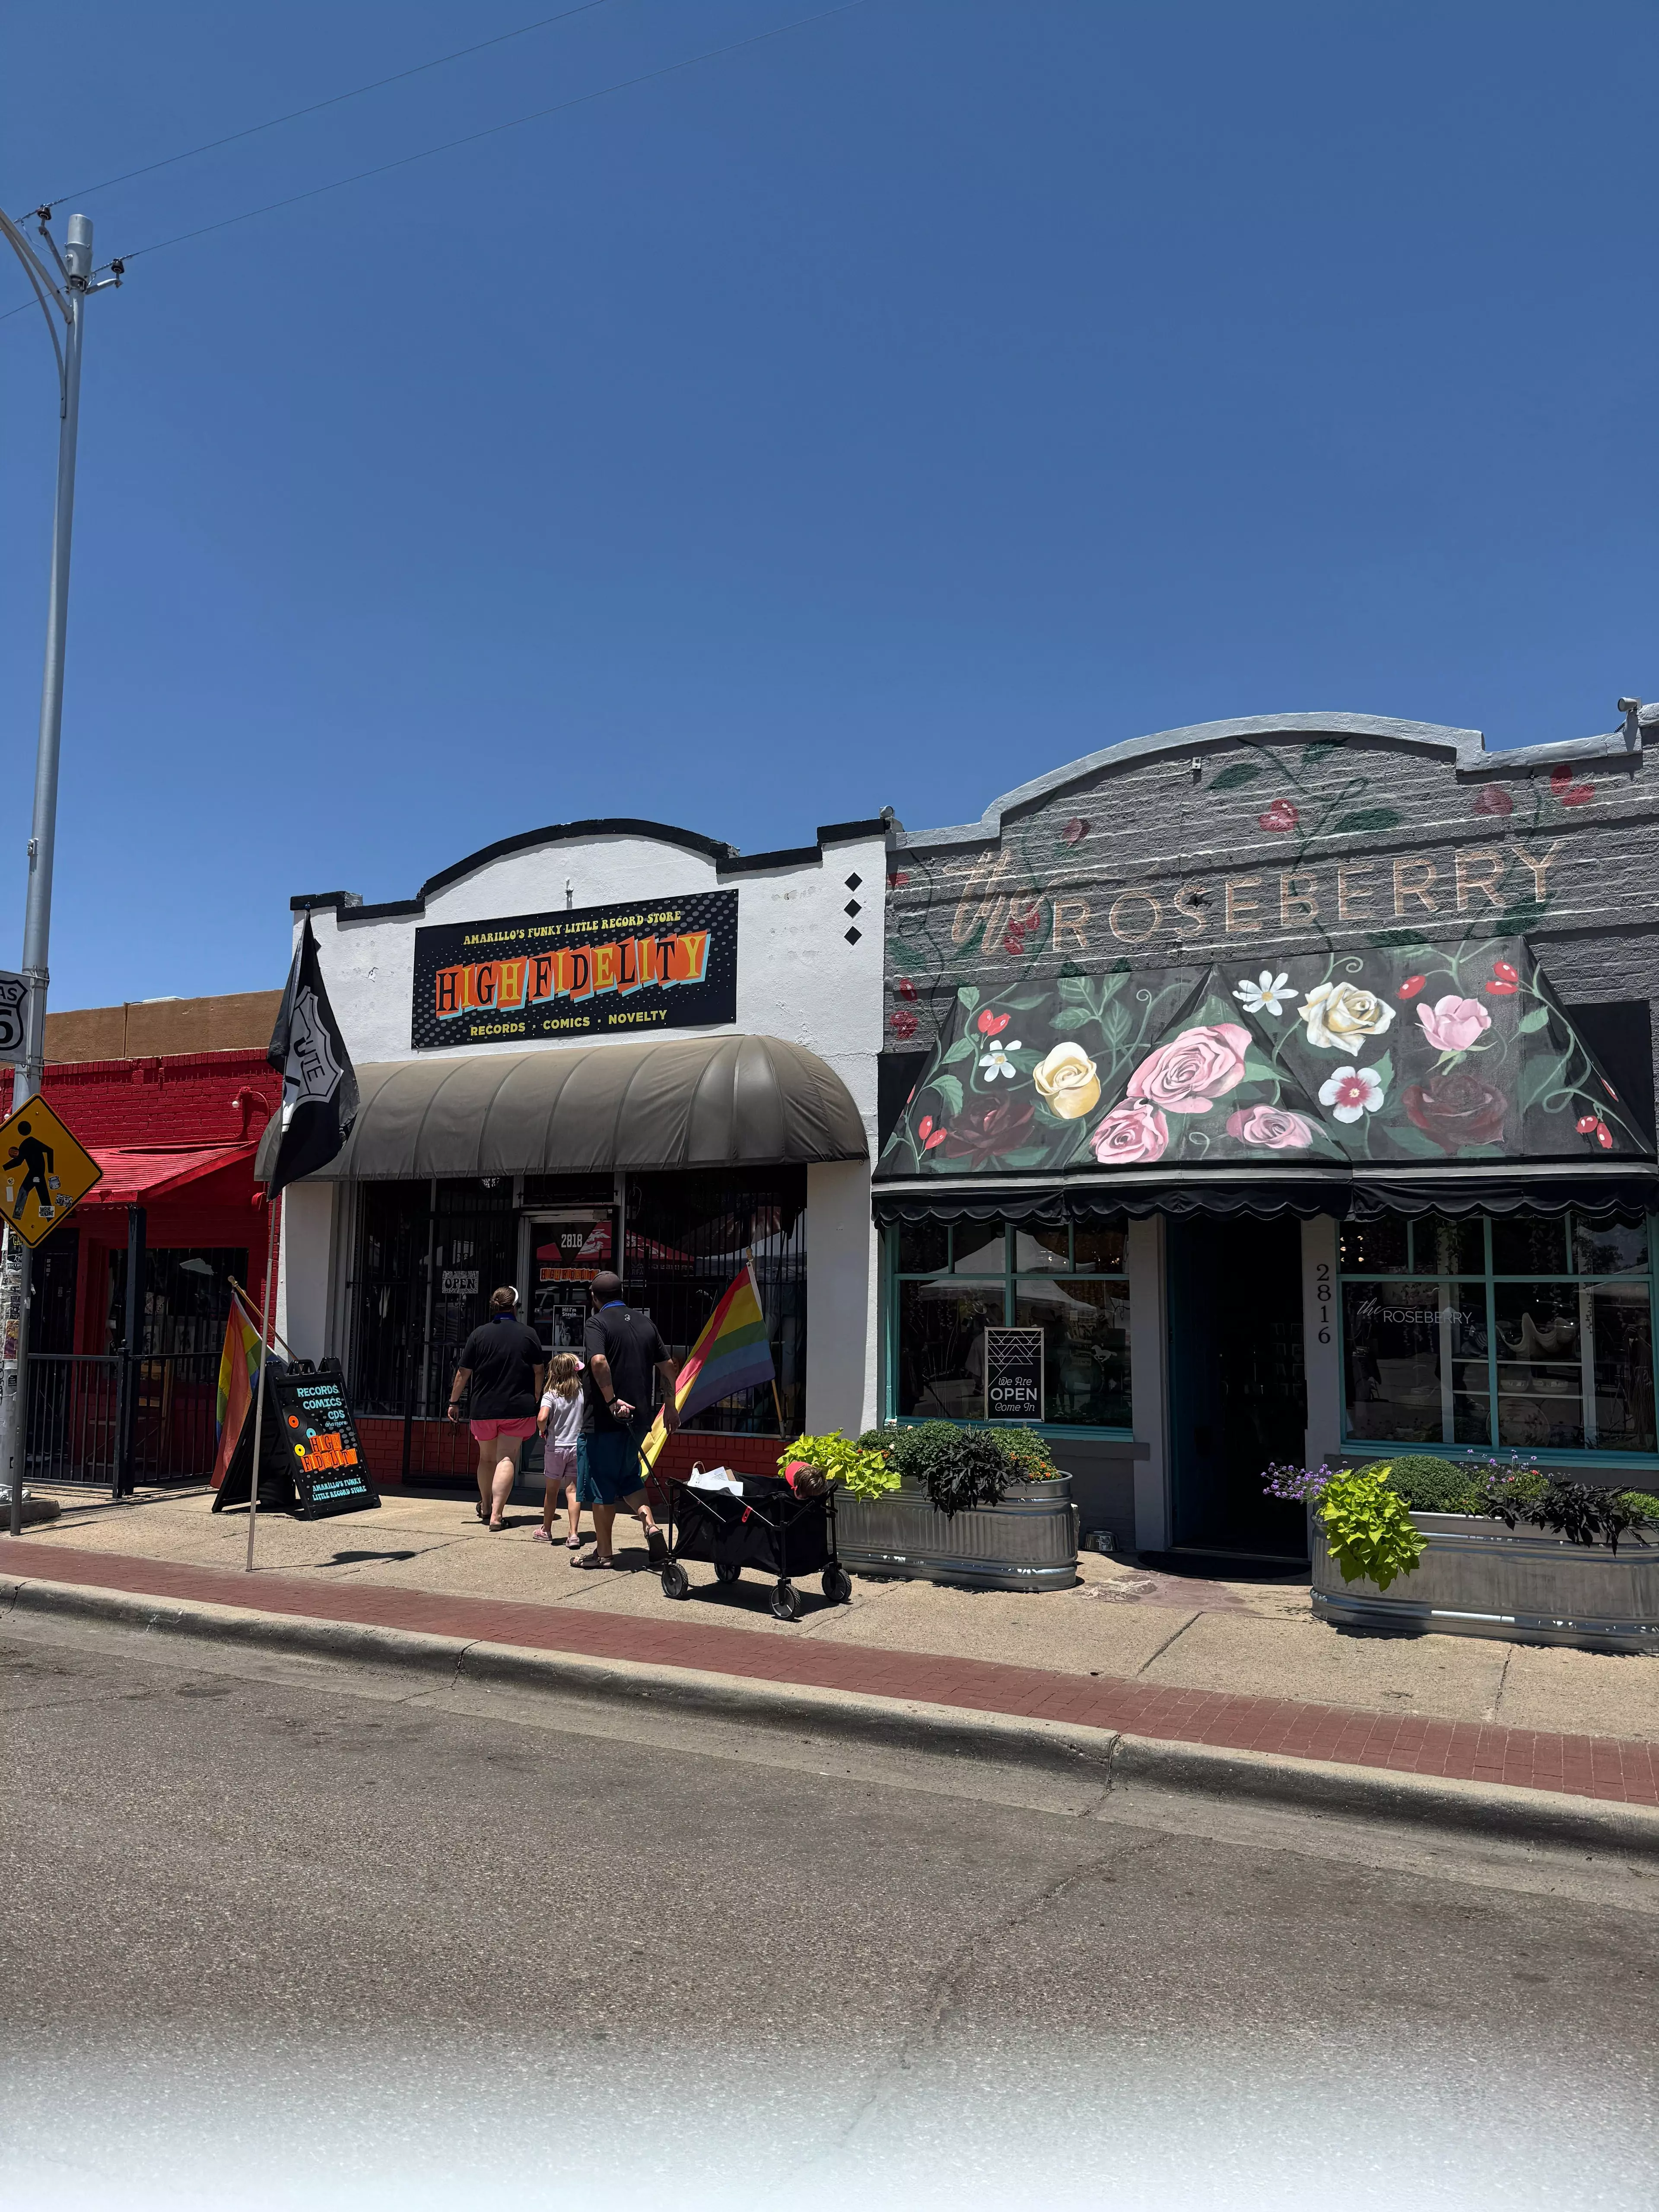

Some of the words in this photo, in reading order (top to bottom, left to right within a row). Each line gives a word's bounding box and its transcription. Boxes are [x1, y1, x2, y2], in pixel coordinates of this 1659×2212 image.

[1052, 841, 1563, 951] ROSEBERRY
[463, 929, 524, 945] AMARILLO'S
[528, 925, 562, 938] FUNKY
[565, 920, 598, 933] LITTLE
[601, 915, 644, 929] RECORD
[647, 911, 681, 924] STORE
[437, 962, 522, 1012] HIGH
[531, 935, 705, 998] FIDELITY
[470, 1022, 526, 1036] RECORDS
[543, 1017, 590, 1030] COMICS
[608, 1009, 667, 1024] NOVELTY
[561, 1233, 582, 1248] 2818
[541, 1269, 561, 1280] HIGH
[445, 1278, 475, 1289] OPEN
[1316, 1264, 1331, 1344] 2816
[1384, 1310, 1472, 1324] ROSEBERRY
[998, 1377, 1012, 1385] We
[1015, 1377, 1032, 1385] Are
[297, 1385, 338, 1397] RECORDS
[990, 1388, 1037, 1401] OPEN
[303, 1397, 342, 1409] COMICS
[995, 1403, 1020, 1411] Come
[1023, 1403, 1035, 1411] In
[327, 1410, 345, 1420] CDS
[310, 1434, 340, 1452] HIGH
[304, 1449, 357, 1471] FIDELITY
[312, 1480, 343, 1491] AMARILLO'S
[344, 1477, 361, 1486] FUNKY
[312, 1493, 330, 1501] LITTLE
[330, 1488, 350, 1498] RECORD
[350, 1485, 367, 1494] STORE
